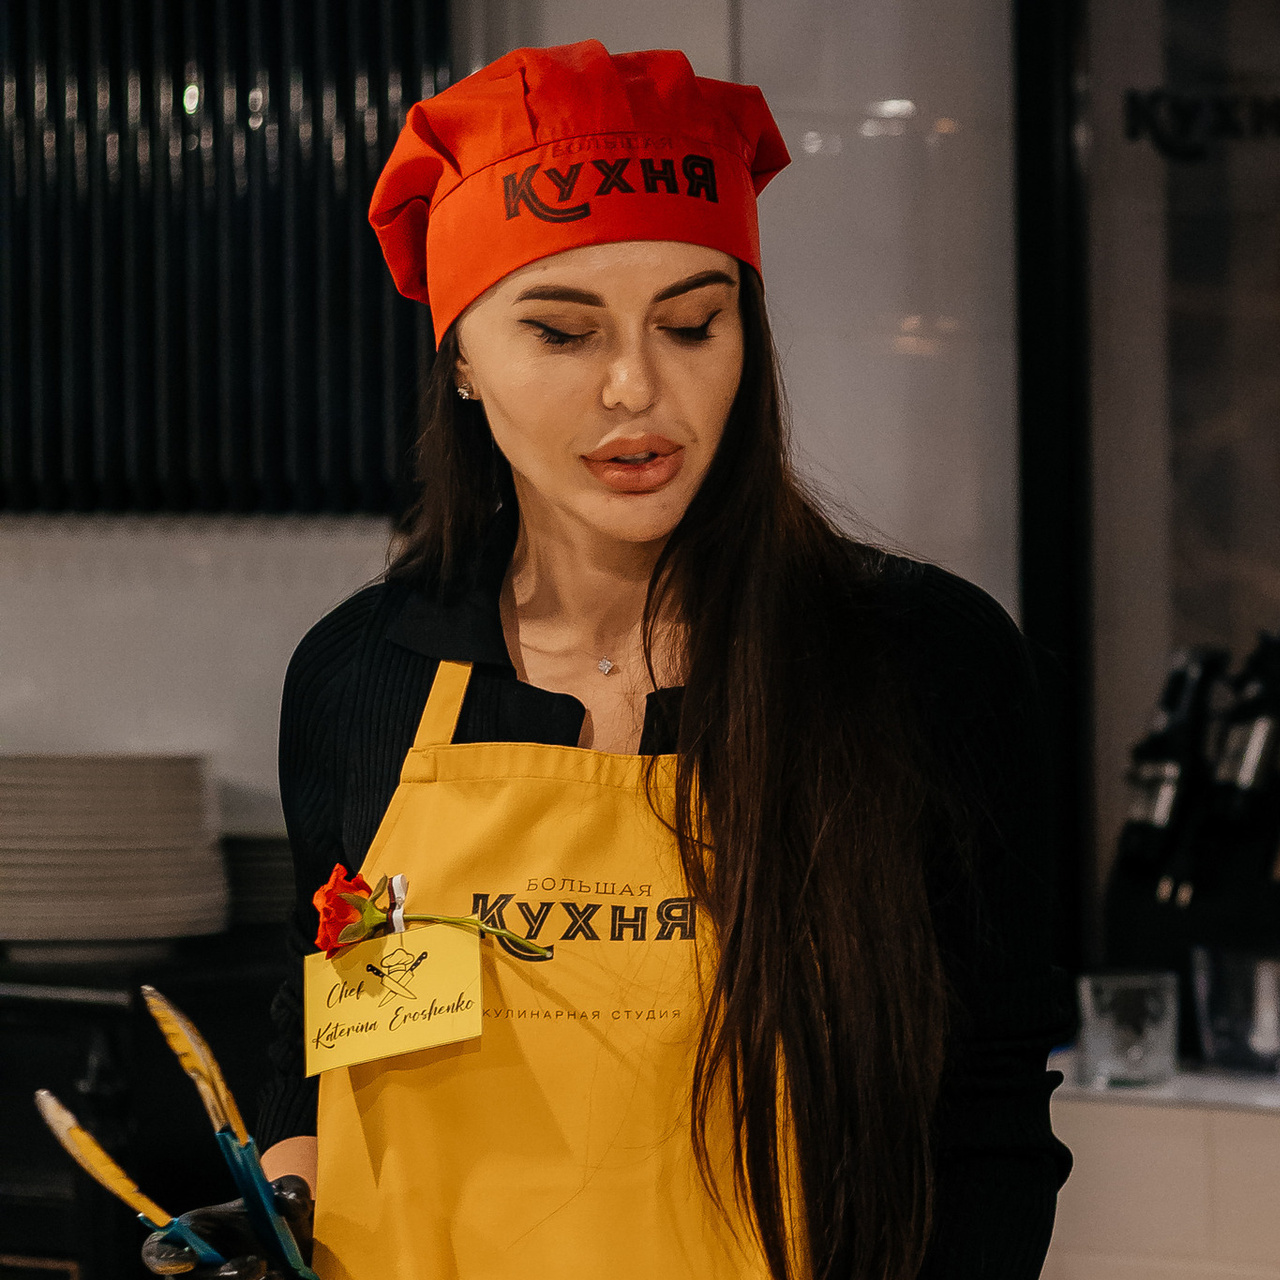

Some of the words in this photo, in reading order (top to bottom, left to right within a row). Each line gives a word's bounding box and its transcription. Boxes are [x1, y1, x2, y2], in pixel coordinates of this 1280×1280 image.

[502, 154, 719, 223] КУХНЯ
[526, 877, 653, 897] БОЛЬШАЯ
[471, 892, 698, 962] КУХНЯ
[327, 980, 365, 1009] Chef
[482, 1008, 601, 1020] КУЛИНАРНАЯ
[611, 1008, 682, 1021] СТУДИЯ
[312, 1021, 379, 1050] Katerina
[388, 991, 475, 1031] Eroshenko
